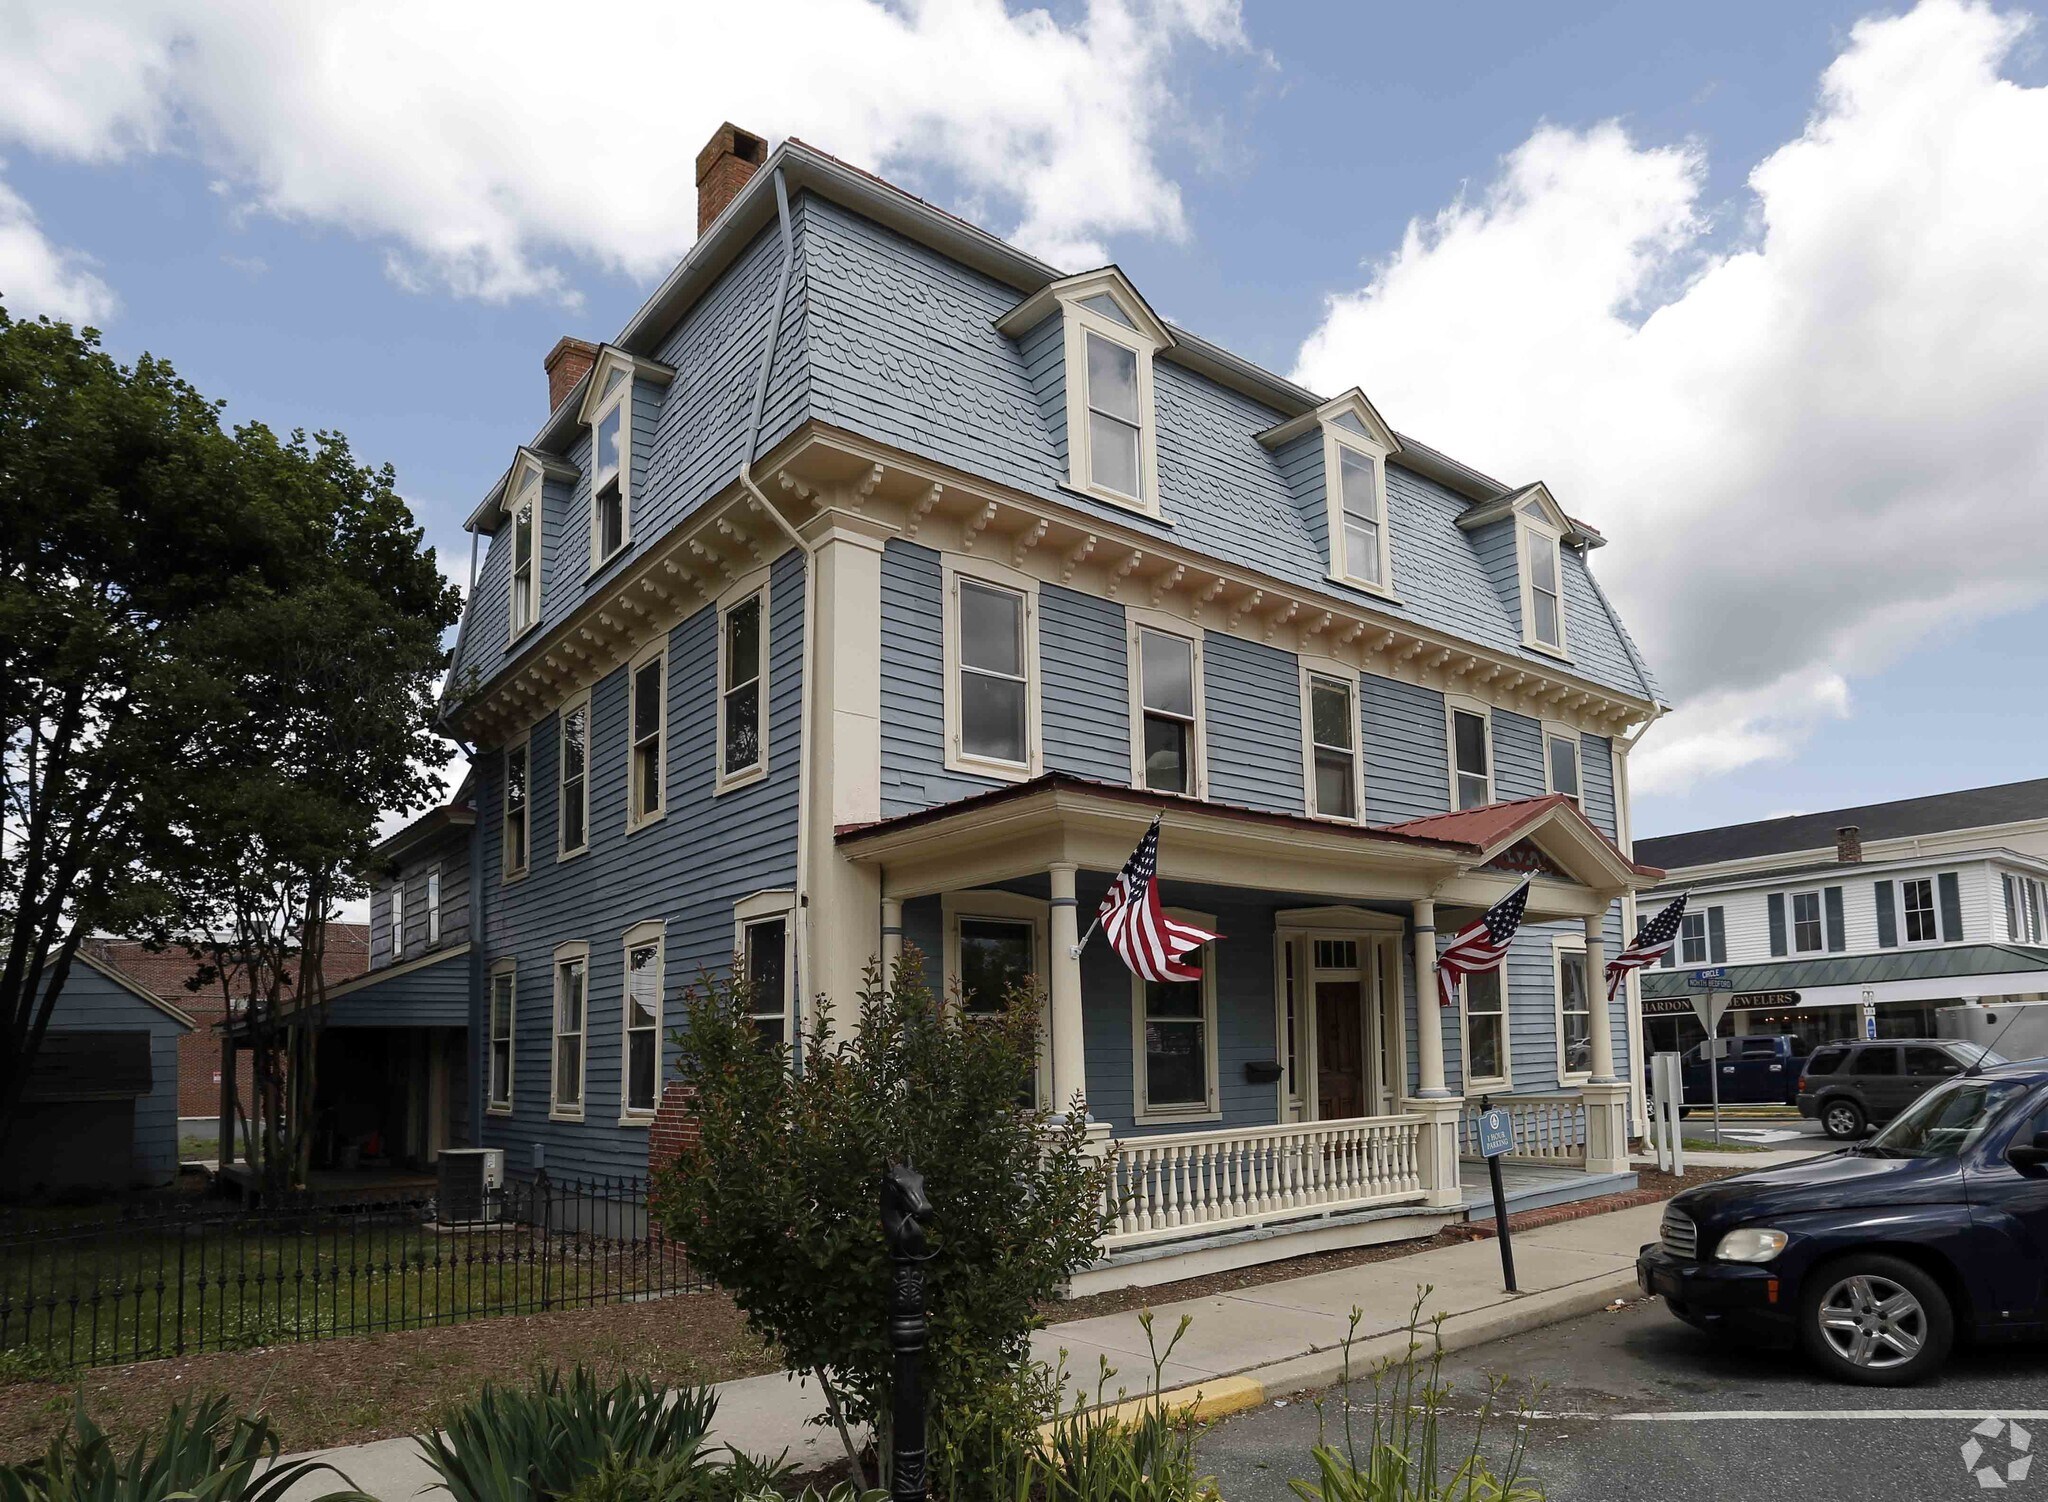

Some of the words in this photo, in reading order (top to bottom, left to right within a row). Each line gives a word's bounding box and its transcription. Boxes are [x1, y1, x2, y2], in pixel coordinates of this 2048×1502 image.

[1702, 969, 1719, 978] CIRCLE
[1708, 980, 1731, 988] BEDFORD
[1491, 1131, 1505, 1141] HOUR
[1487, 1138, 1509, 1150] PARKING
